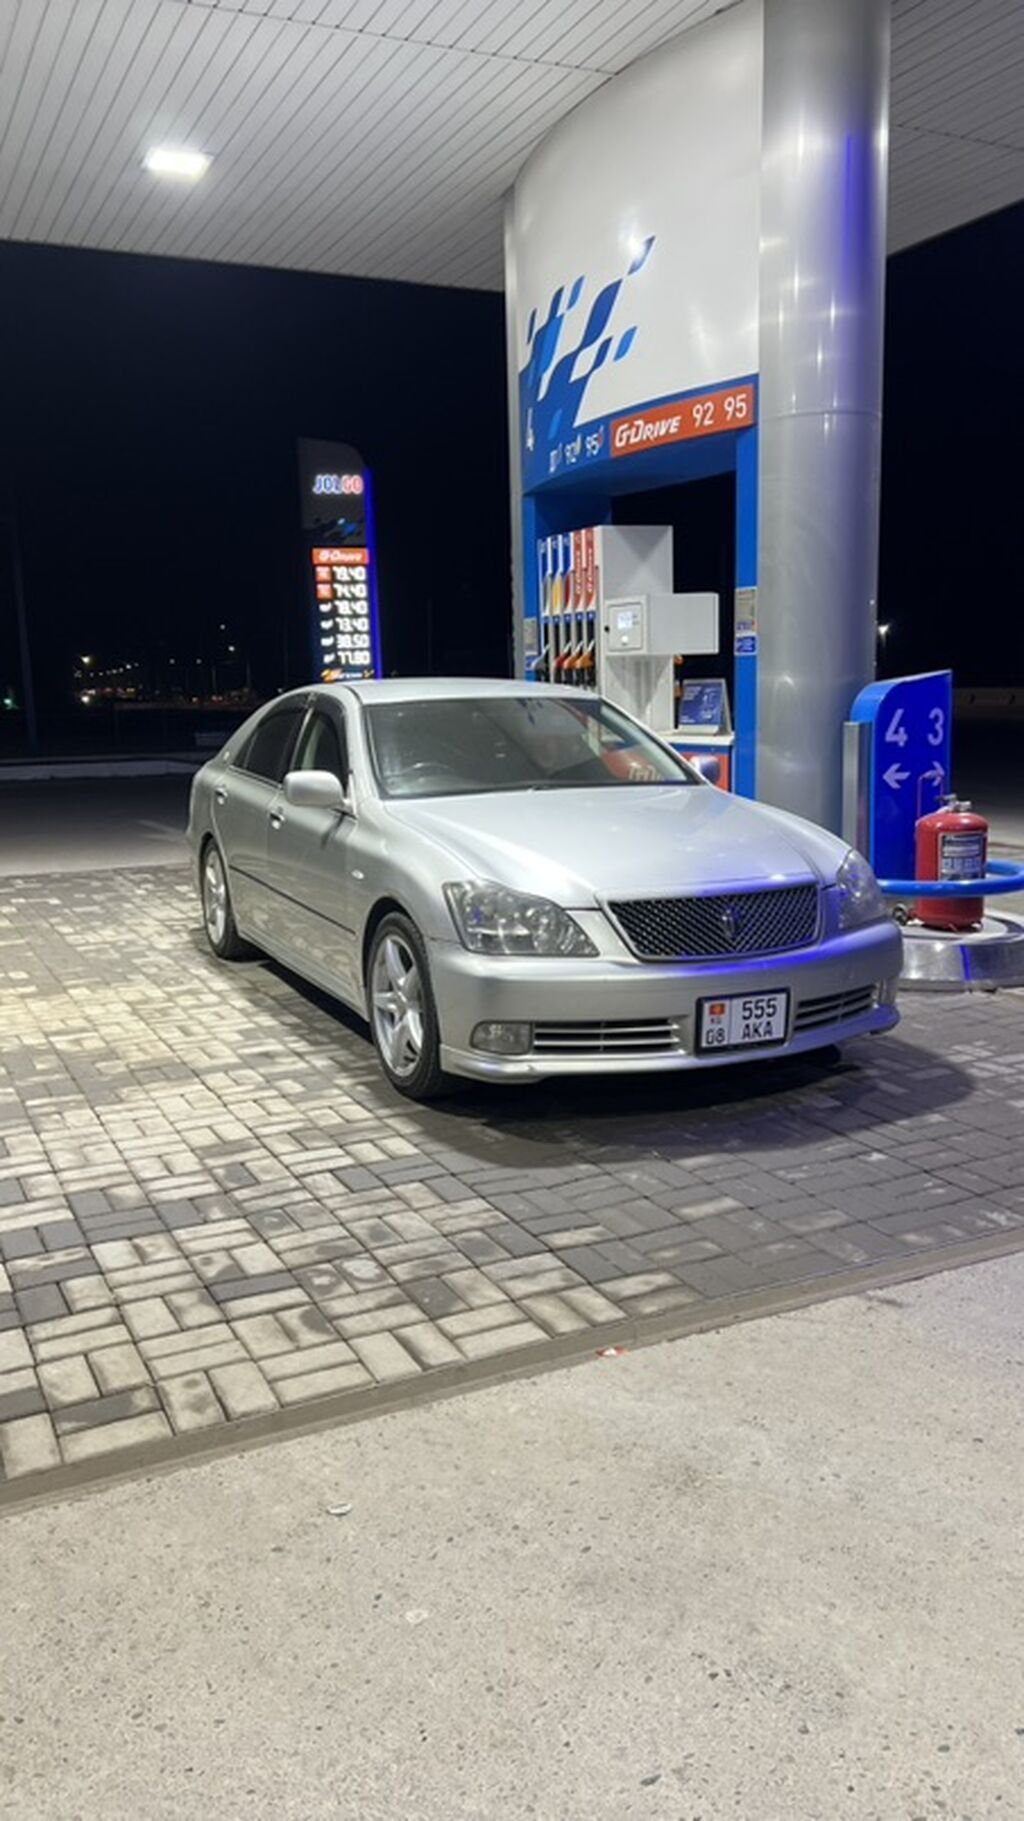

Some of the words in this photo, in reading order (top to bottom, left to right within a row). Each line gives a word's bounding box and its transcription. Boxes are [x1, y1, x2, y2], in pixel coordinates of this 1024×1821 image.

[692, 401, 714, 427] 92
[723, 394, 747, 421] 95
[313, 475, 364, 494] JOLGO
[885, 708, 908, 746] 4
[928, 707, 944, 745] 3
[742, 997, 777, 1020] 555
[742, 1021, 774, 1040] AKA
